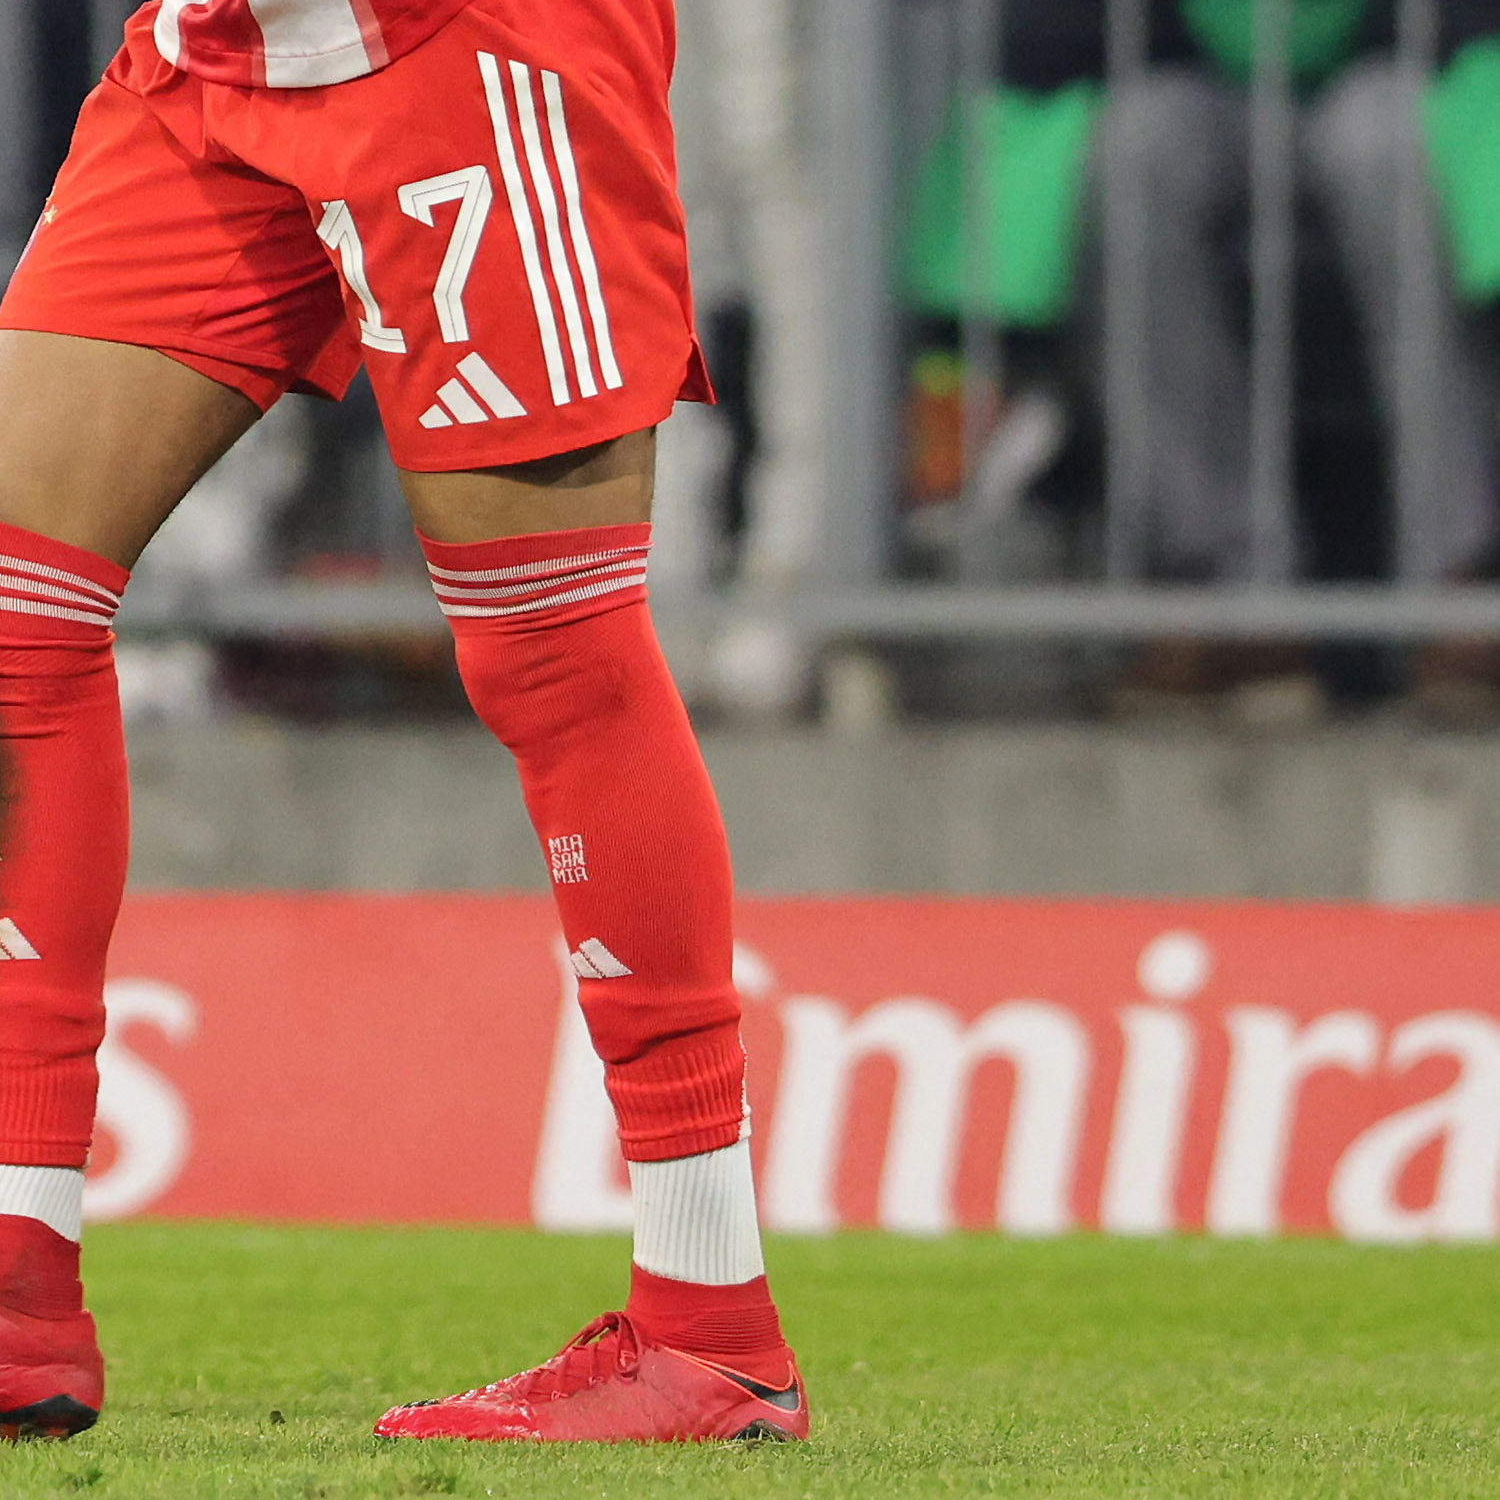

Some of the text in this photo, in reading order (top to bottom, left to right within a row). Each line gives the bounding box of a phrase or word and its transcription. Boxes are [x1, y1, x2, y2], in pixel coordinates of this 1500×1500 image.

[316, 164, 493, 354] 17
[548, 833, 583, 853] MIA
[551, 849, 586, 869] SAN
[552, 866, 589, 884] MIA
